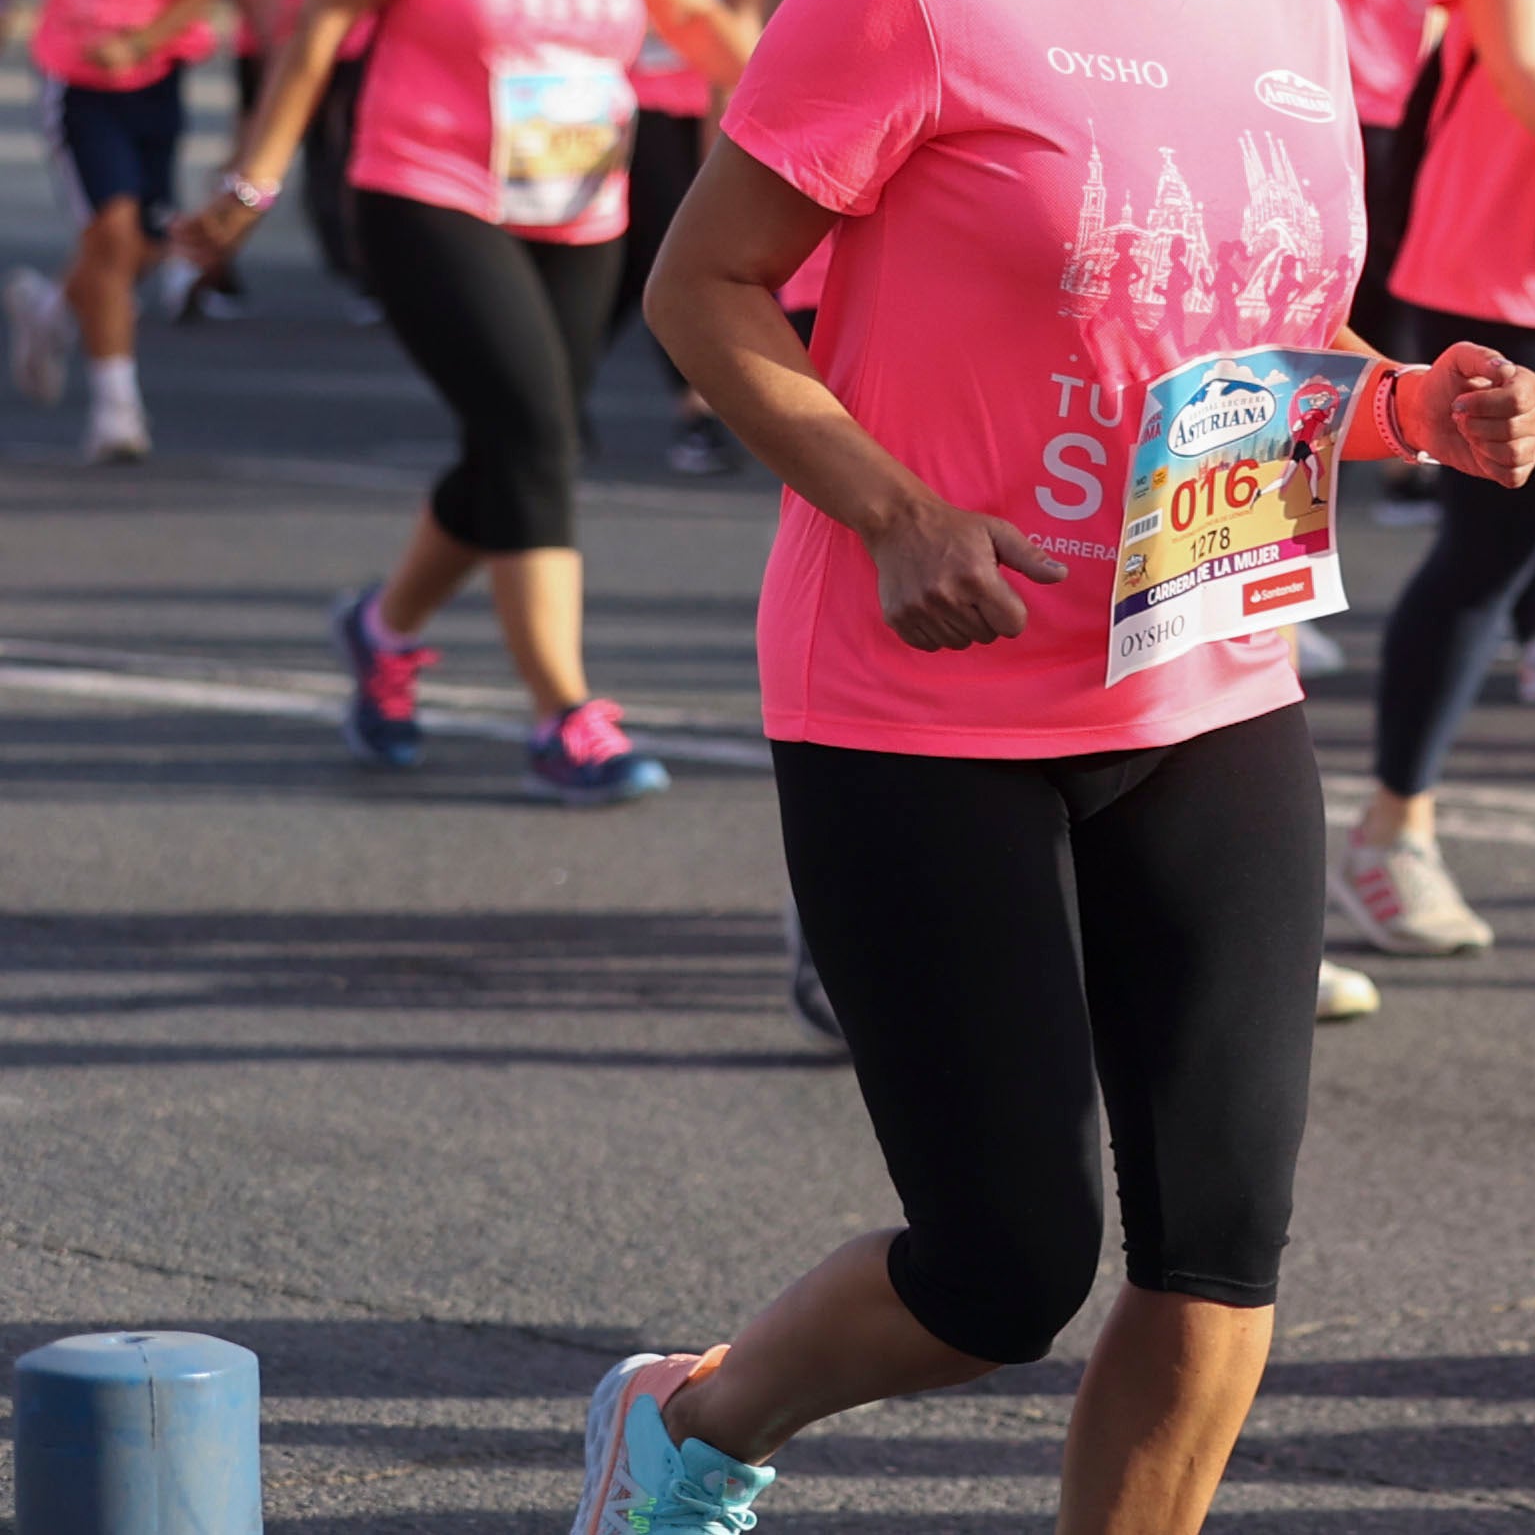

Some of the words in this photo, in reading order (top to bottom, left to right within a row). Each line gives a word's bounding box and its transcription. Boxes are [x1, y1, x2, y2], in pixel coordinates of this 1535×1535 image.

[1047, 47, 1168, 89] OYSHO
[1051, 373, 1123, 428] TU
[1174, 405, 1267, 449] ASTURIANA
[1170, 458, 1260, 533] 016
[1190, 526, 1231, 563] 1278
[1147, 570, 1196, 606] CARRERA
[1213, 558, 1232, 577] LA
[1233, 544, 1280, 572] MUJER
[1261, 581, 1305, 601] Santander
[1120, 615, 1186, 658] OYSHO
